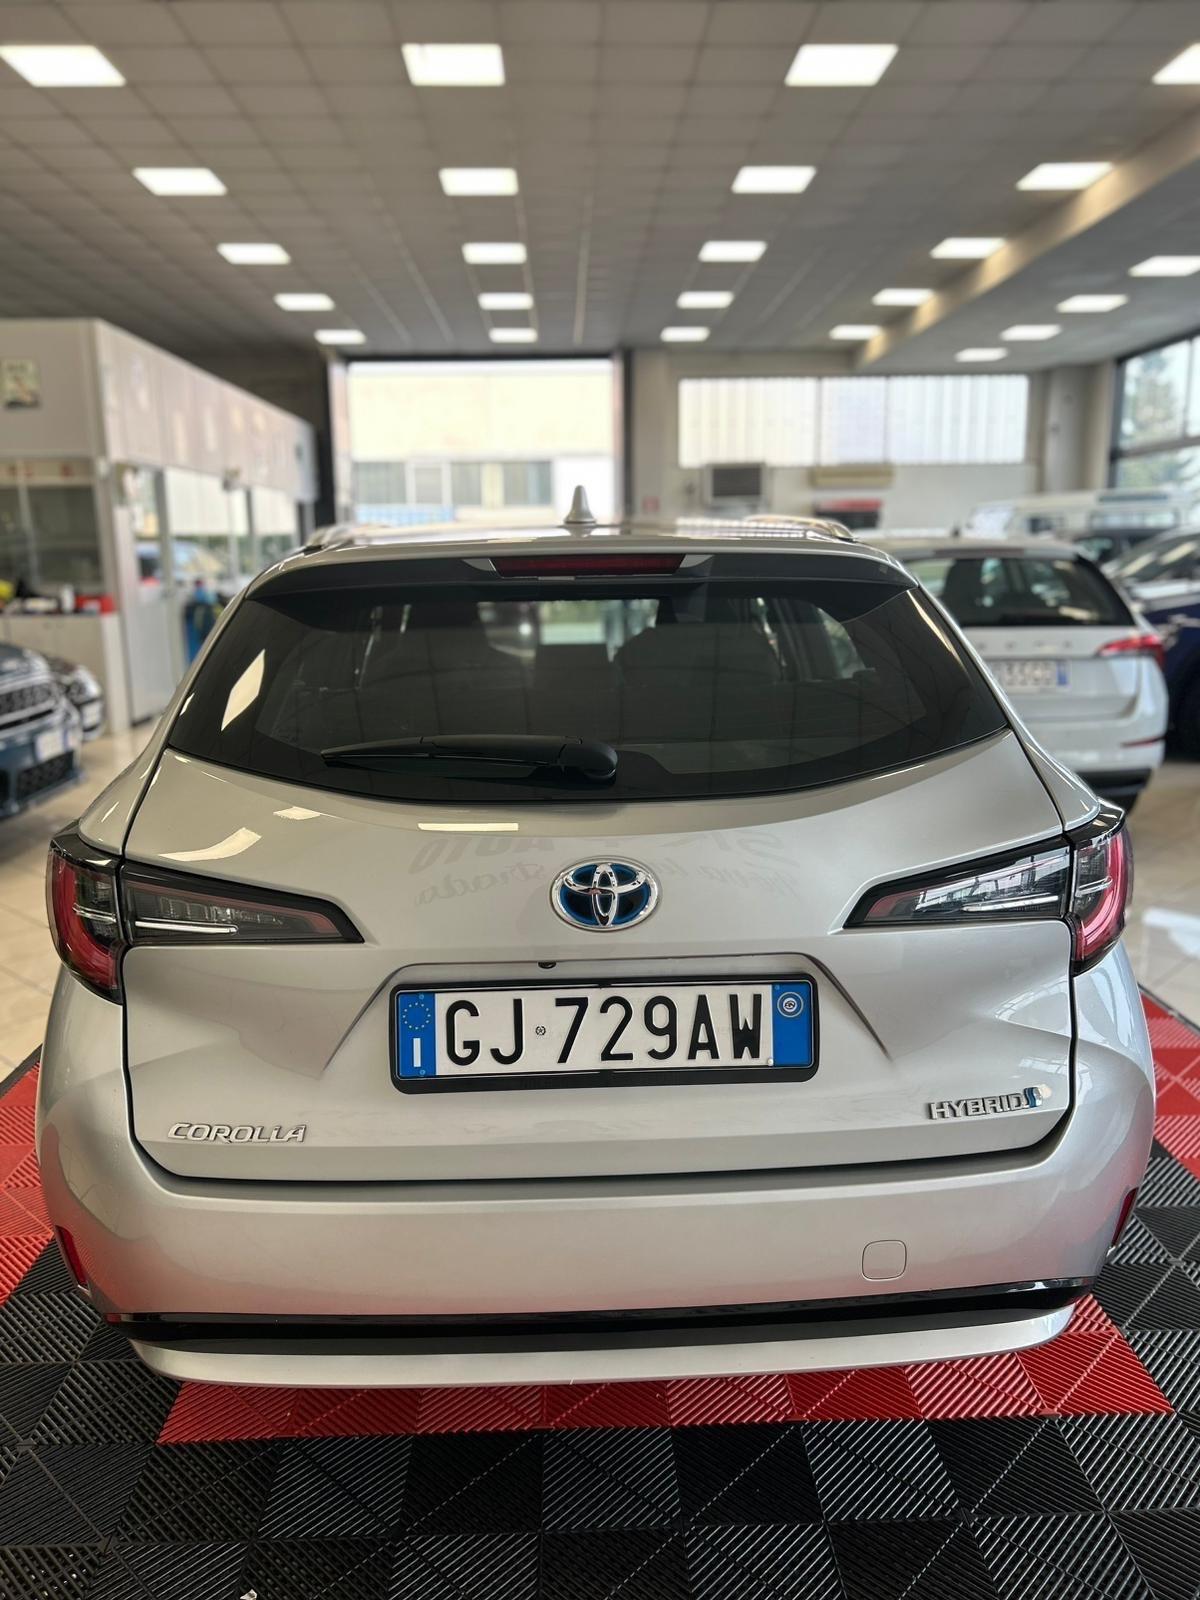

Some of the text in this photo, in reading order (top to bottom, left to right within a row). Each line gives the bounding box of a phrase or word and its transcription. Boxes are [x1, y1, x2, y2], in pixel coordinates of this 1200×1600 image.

[444, 993, 763, 1067] GJ 729AW
[928, 1092, 1023, 1121] HYBRID
[167, 1121, 307, 1145] COROLLA
